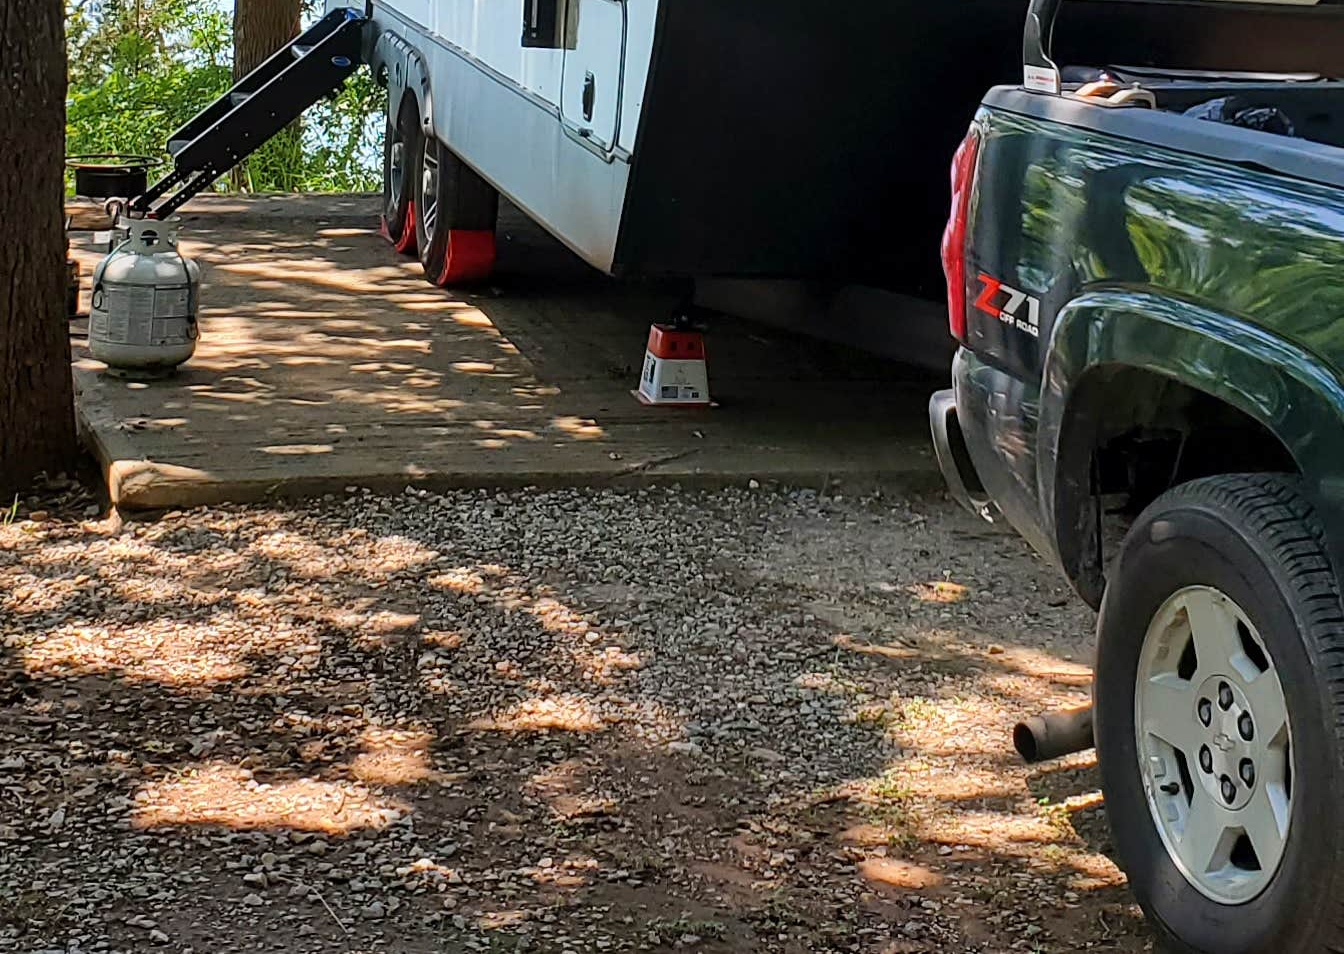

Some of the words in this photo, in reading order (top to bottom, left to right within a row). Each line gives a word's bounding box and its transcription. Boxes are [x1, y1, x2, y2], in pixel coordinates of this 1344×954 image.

[975, 272, 1040, 327] Z71
[999, 311, 1015, 325] OFF
[1016, 319, 1039, 338] ROAD
